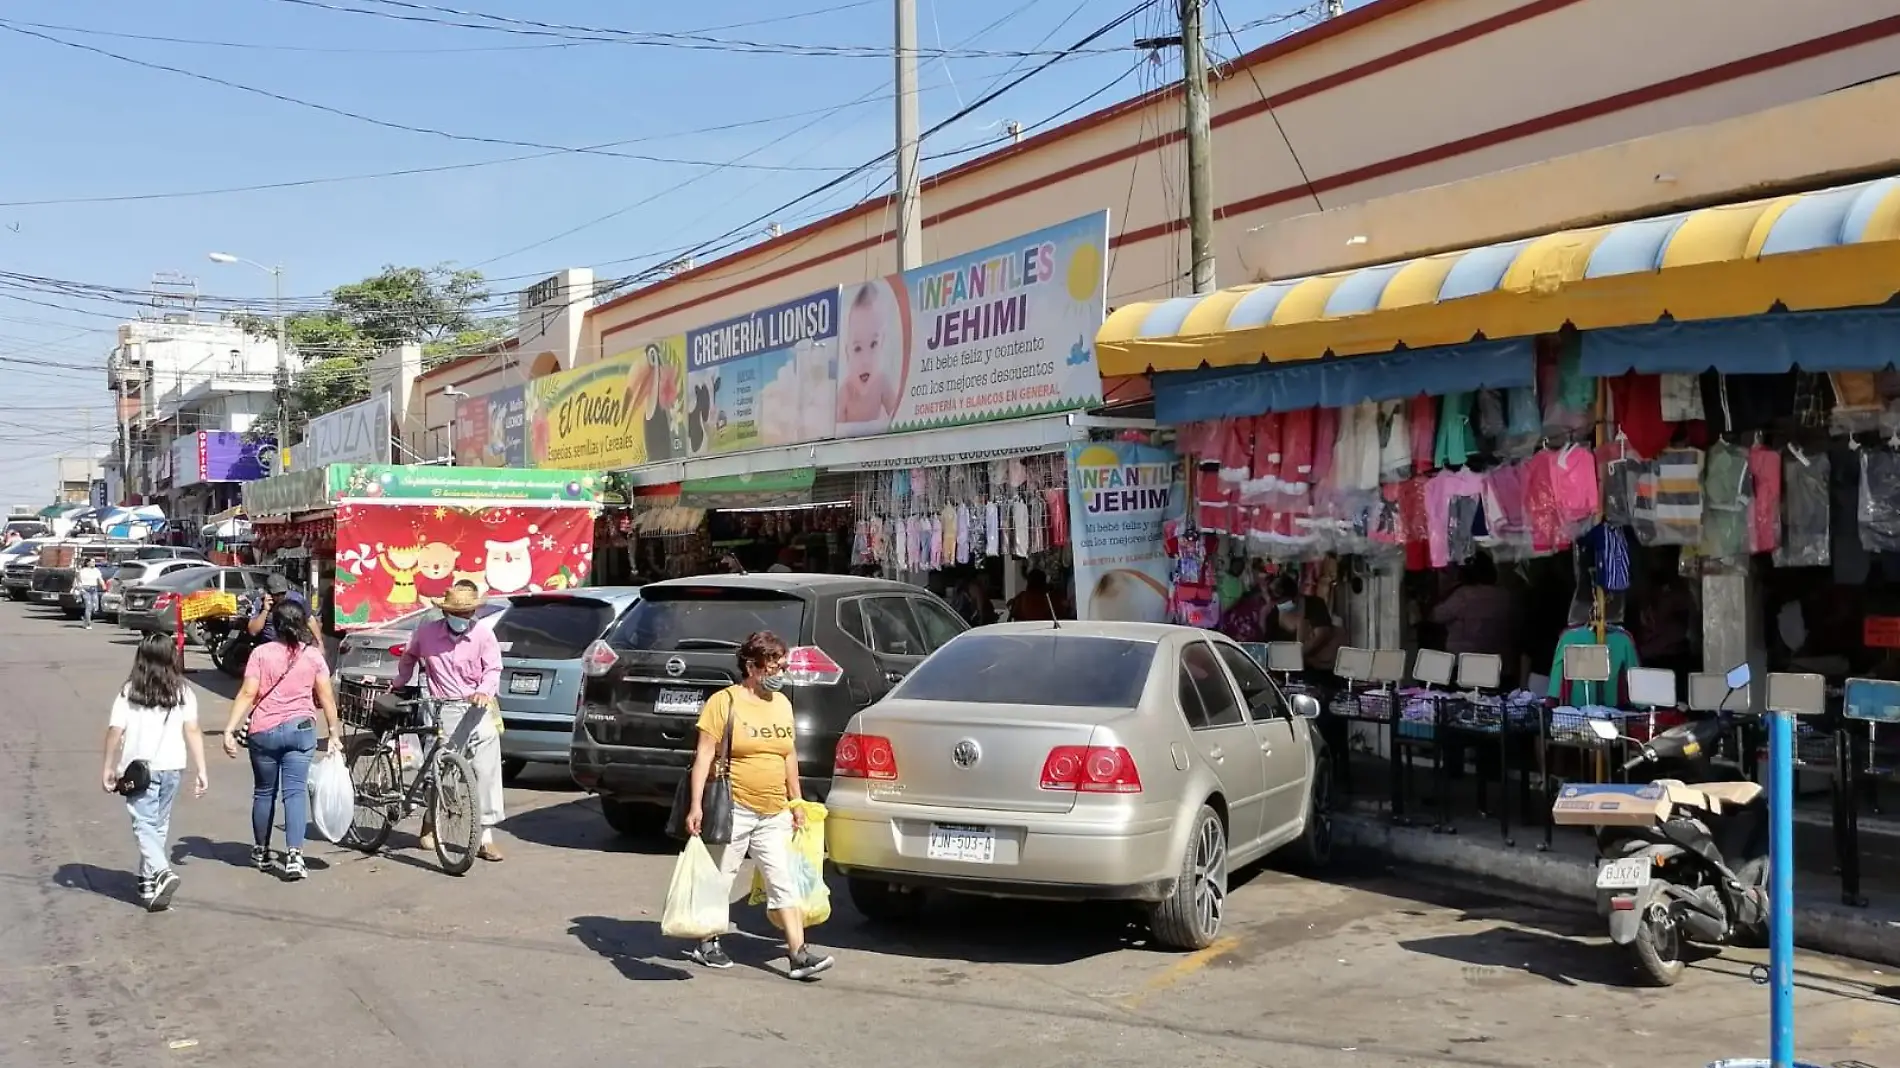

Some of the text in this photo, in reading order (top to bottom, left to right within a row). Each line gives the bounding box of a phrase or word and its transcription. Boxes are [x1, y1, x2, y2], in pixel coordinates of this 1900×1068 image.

[920, 243, 1055, 312] INFANTILES
[694, 298, 830, 366] CREMERÍA LIONSO
[927, 294, 1027, 350] JEHIMI
[911, 361, 1054, 397] con los mejores descuentos
[920, 358, 933, 372] Mi
[961, 350, 982, 365] feliz
[985, 348, 992, 365] y
[995, 337, 1044, 358] contento
[559, 387, 621, 439] El Tucán
[966, 392, 1004, 408] BLANCOS
[1006, 390, 1017, 401] EN
[1020, 383, 1061, 399] GENERAL
